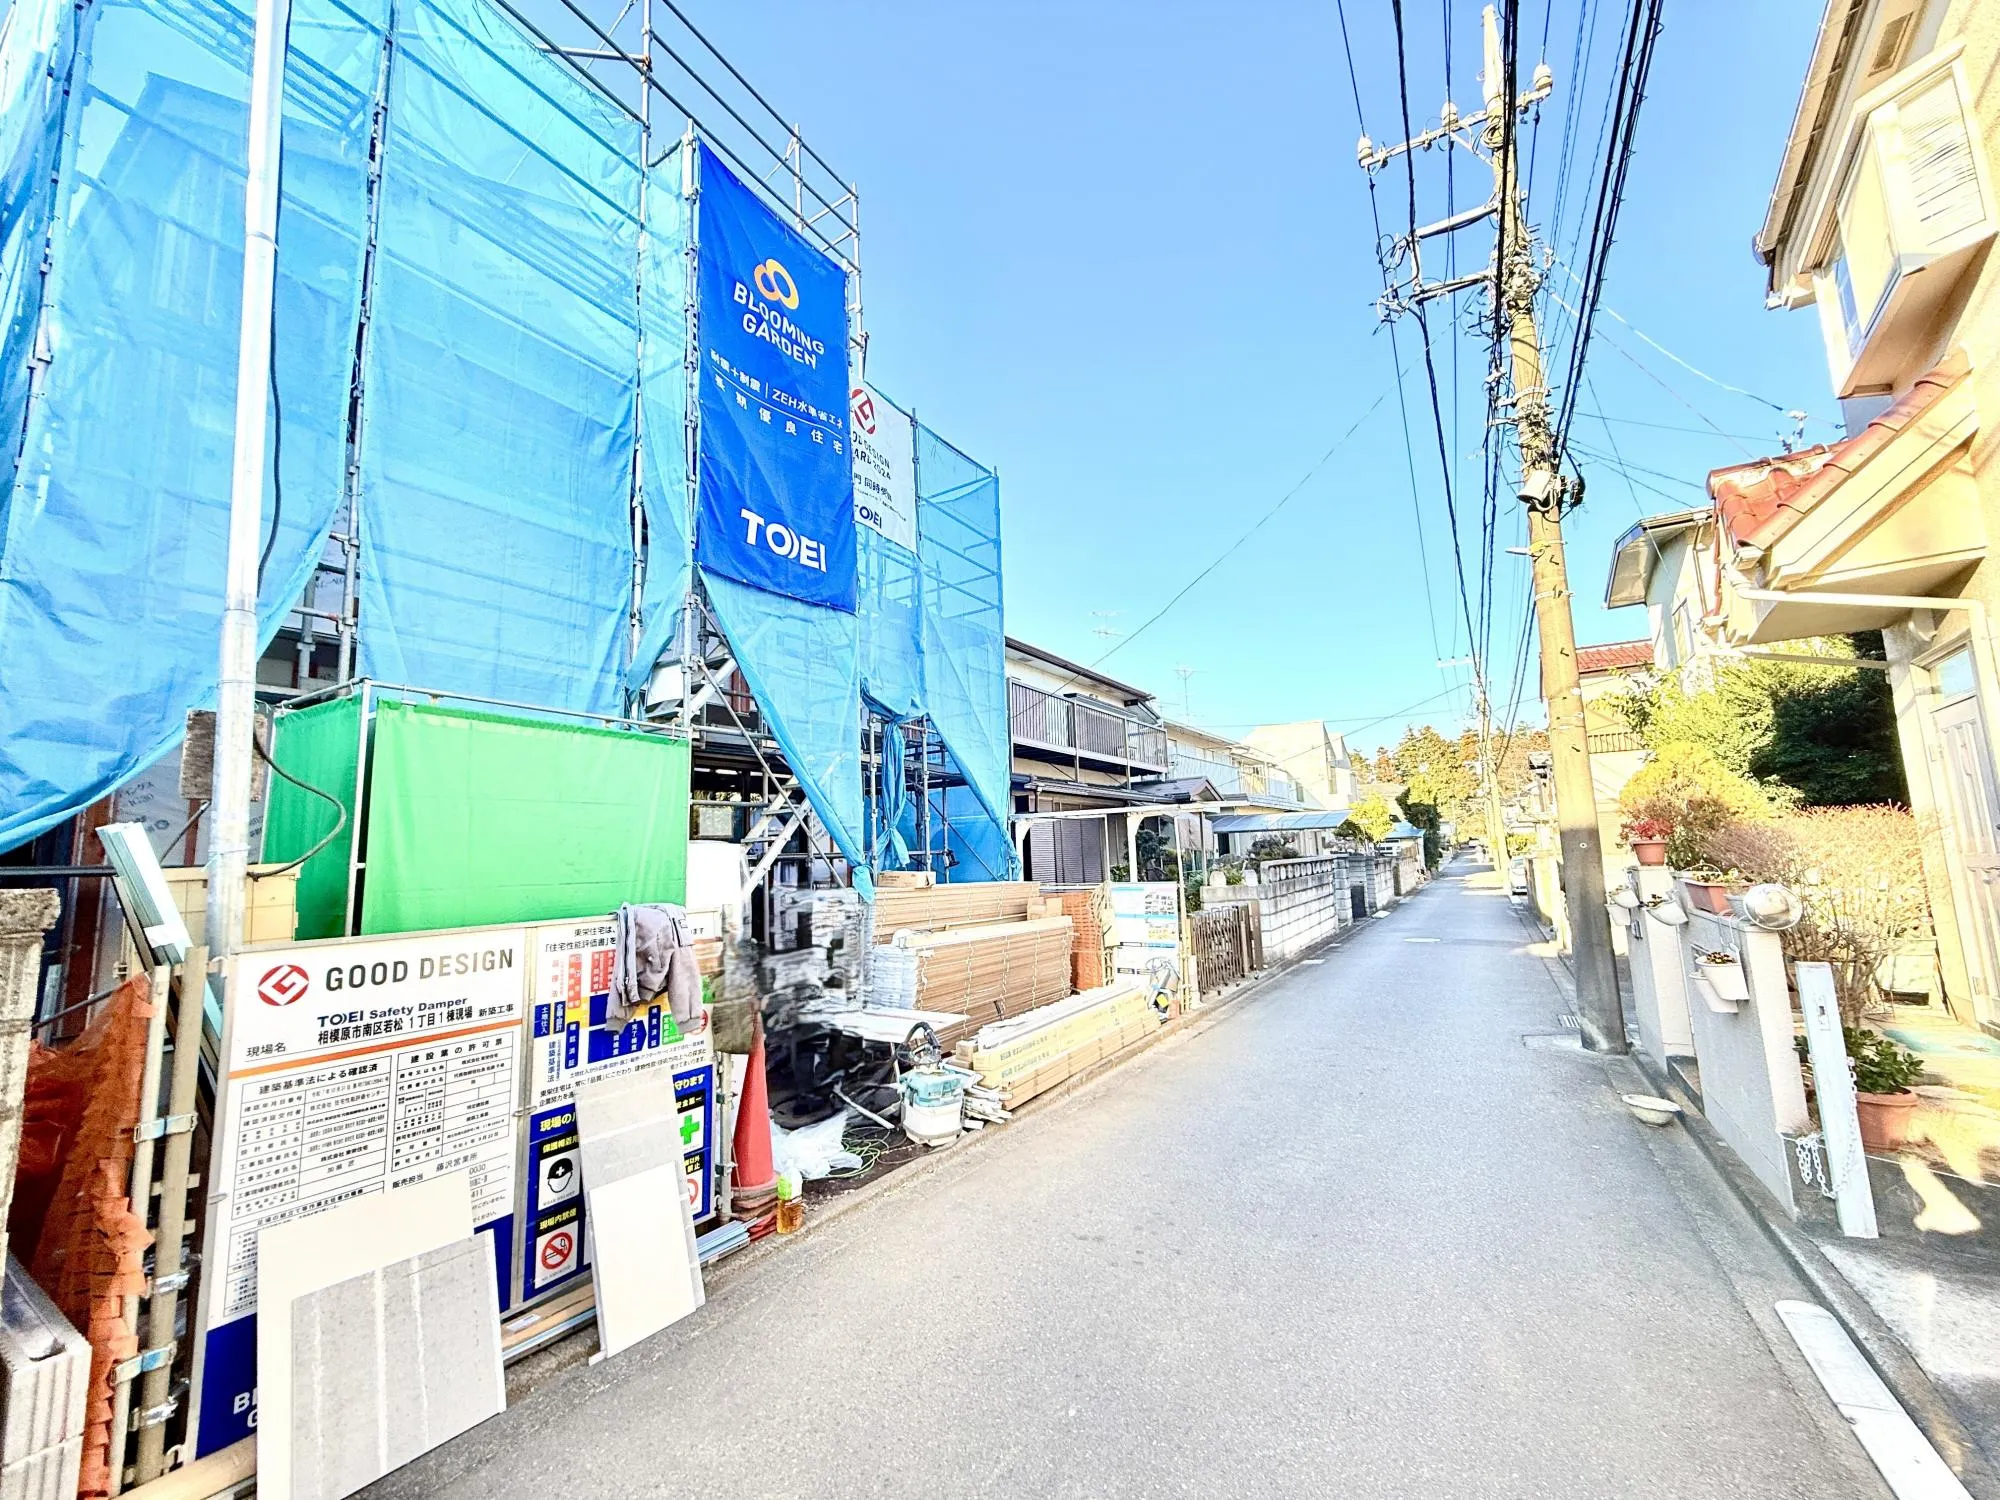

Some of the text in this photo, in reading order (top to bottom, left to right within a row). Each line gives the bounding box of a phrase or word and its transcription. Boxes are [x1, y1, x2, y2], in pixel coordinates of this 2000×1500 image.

[733, 281, 825, 355] BLOOMING
[742, 313, 818, 370] GARDEN
[714, 374, 844, 455] 長期優良住宅
[873, 460, 892, 480] 2024
[740, 508, 827, 573] TOEI
[545, 937, 616, 953] 「住宅性能評価書」を
[574, 926, 616, 937] 東栄住宅は、
[325, 948, 514, 992] GOOD DESIGN
[317, 998, 468, 1028] TOEI Safety Damper
[317, 1018, 404, 1045] 相模原市南区若松
[478, 1003, 514, 1018] 新築工事
[540, 1006, 549, 1034] 土地仕入
[246, 1042, 287, 1057] 現場名
[410, 1038, 503, 1063] 建設業の許可票
[258, 1063, 378, 1095] 建築基準法による確認済
[674, 1074, 705, 1091] 守ります
[392, 1173, 424, 1189] 販売担当
[539, 1207, 577, 1230] 現場内禁煙
